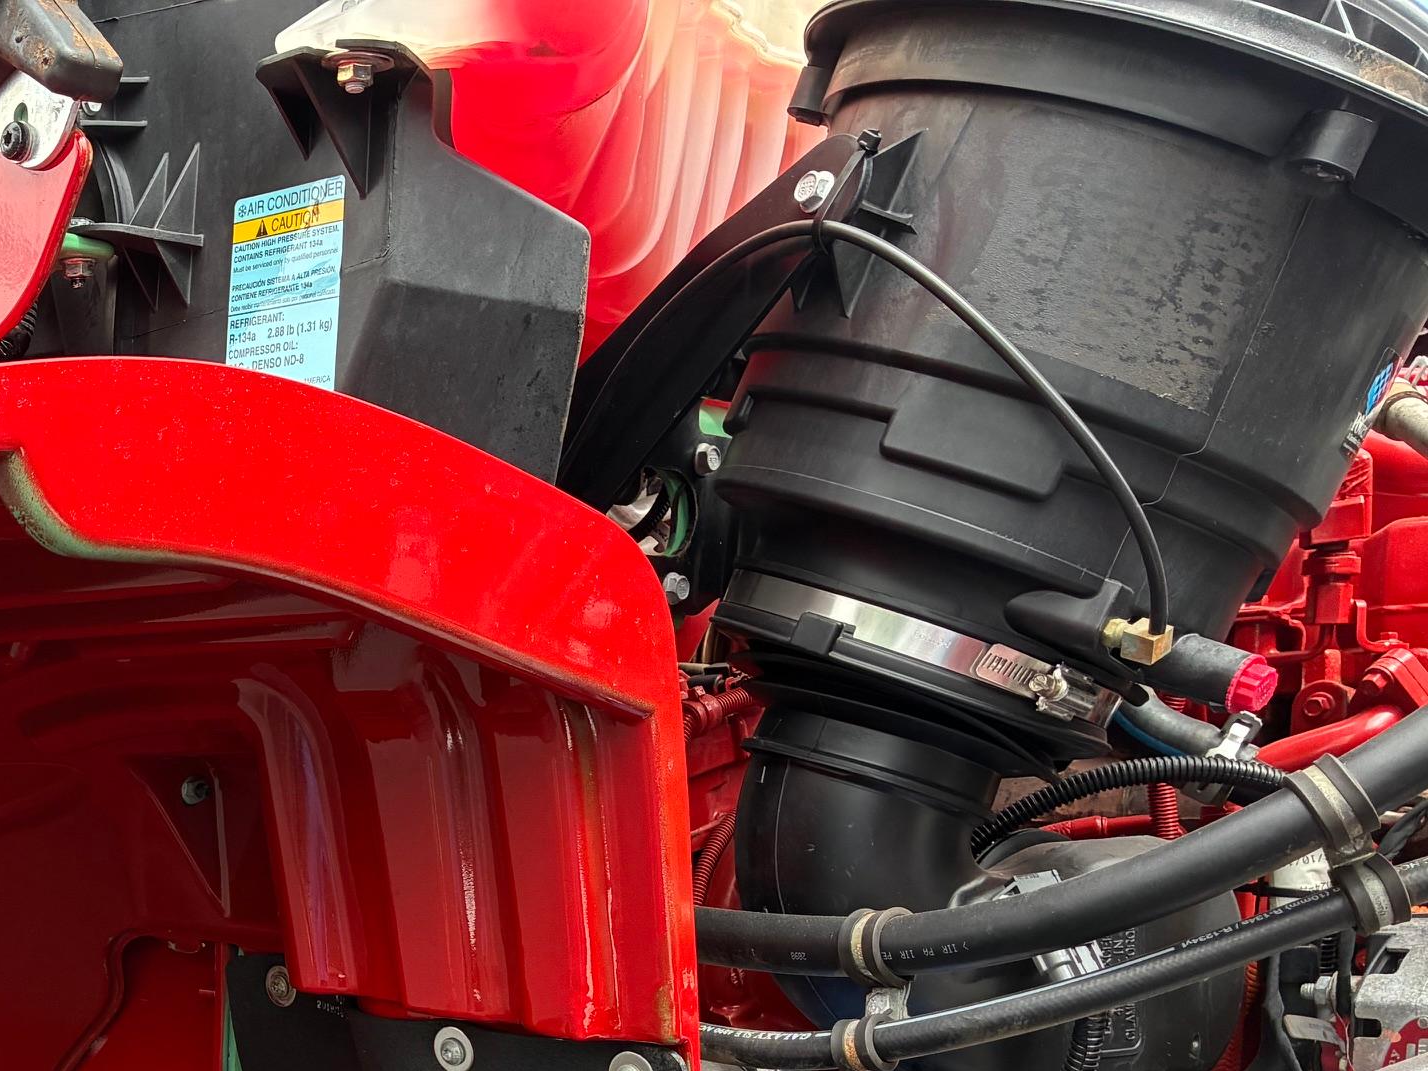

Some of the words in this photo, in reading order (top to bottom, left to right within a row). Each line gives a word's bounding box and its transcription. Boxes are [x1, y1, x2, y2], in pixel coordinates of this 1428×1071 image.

[247, 199, 265, 215] AIR
[268, 180, 343, 210] CONDITIONER
[271, 208, 319, 231] CAUTION
[234, 241, 260, 253] CAUTION
[261, 238, 276, 247] HIGH
[278, 230, 310, 243] PRESSURE
[234, 251, 263, 263] CONTAINS
[265, 242, 307, 256] REFRIGERANT
[309, 238, 323, 247] 134a
[253, 260, 271, 269] serviced
[273, 258, 283, 266] only
[291, 252, 312, 262] qualified
[232, 278, 264, 291] PRECAUCIÓN
[267, 274, 290, 284] SISTEMA
[297, 270, 310, 278] ALTA
[231, 291, 257, 302] CONTIENE
[259, 283, 299, 297] REFRIGERANTE
[229, 311, 285, 329] REFRIGERANT:
[229, 331, 256, 344] R-134a
[267, 326, 284, 338] 2.88
[286, 324, 295, 335] lb
[296, 320, 316, 335] (1.31
[319, 318, 333, 332] kg)
[228, 343, 281, 359] COMPRESSOR
[283, 340, 298, 350] OIL:
[251, 356, 282, 370] DENSO
[284, 353, 305, 366] ND-8
[1284, 892, 1330, 911] (10mm)
[1241, 908, 1285, 926] R-134a
[1180, 925, 1233, 950] R-1234yf
[754, 1031, 812, 1040] GALAXY
